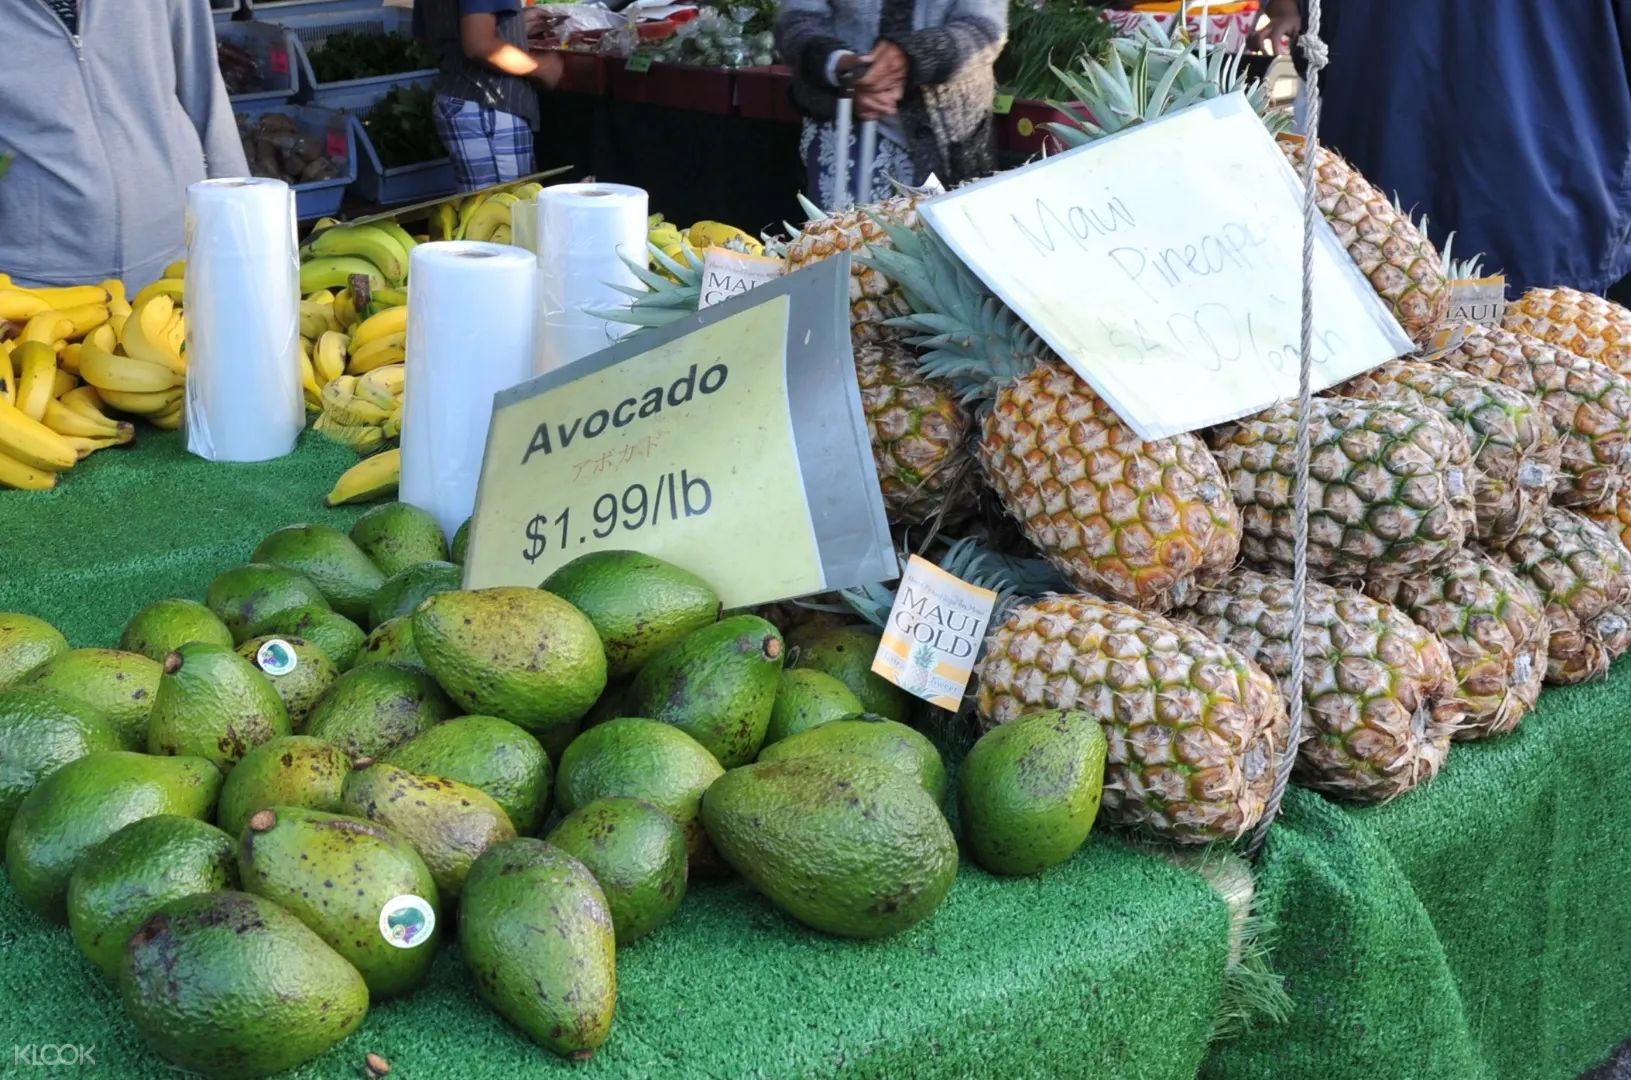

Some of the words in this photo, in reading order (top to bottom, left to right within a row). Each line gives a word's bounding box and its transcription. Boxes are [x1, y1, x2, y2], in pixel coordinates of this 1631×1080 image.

[1009, 186, 1137, 258] Maui
[520, 361, 729, 465] Avocado
[521, 469, 713, 564] $1.99/lb
[894, 610, 973, 659] GOLD
[900, 586, 983, 638] MAUI
